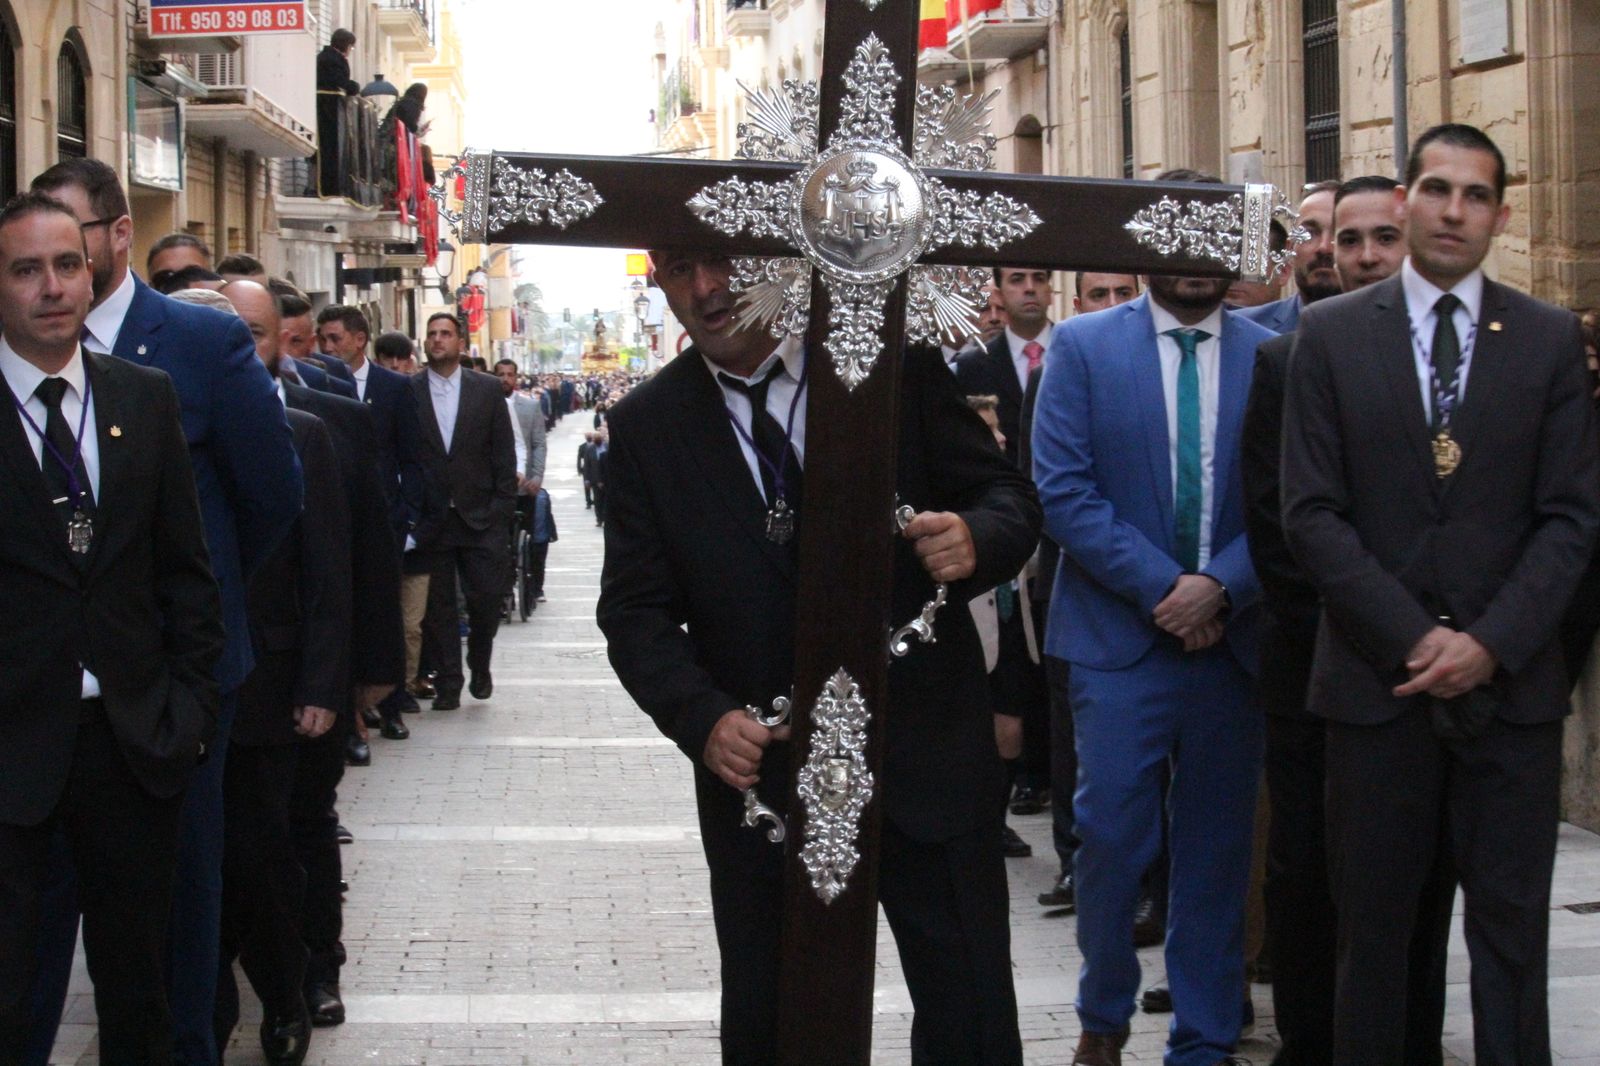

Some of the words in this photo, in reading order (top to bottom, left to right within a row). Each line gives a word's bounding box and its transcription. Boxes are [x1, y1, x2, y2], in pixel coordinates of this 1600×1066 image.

[159, 13, 186, 31] Tlf.
[190, 11, 221, 30] 950
[226, 10, 247, 28] 39
[251, 9, 271, 27] 08
[277, 8, 298, 27] 03
[832, 209, 890, 241] JHS
